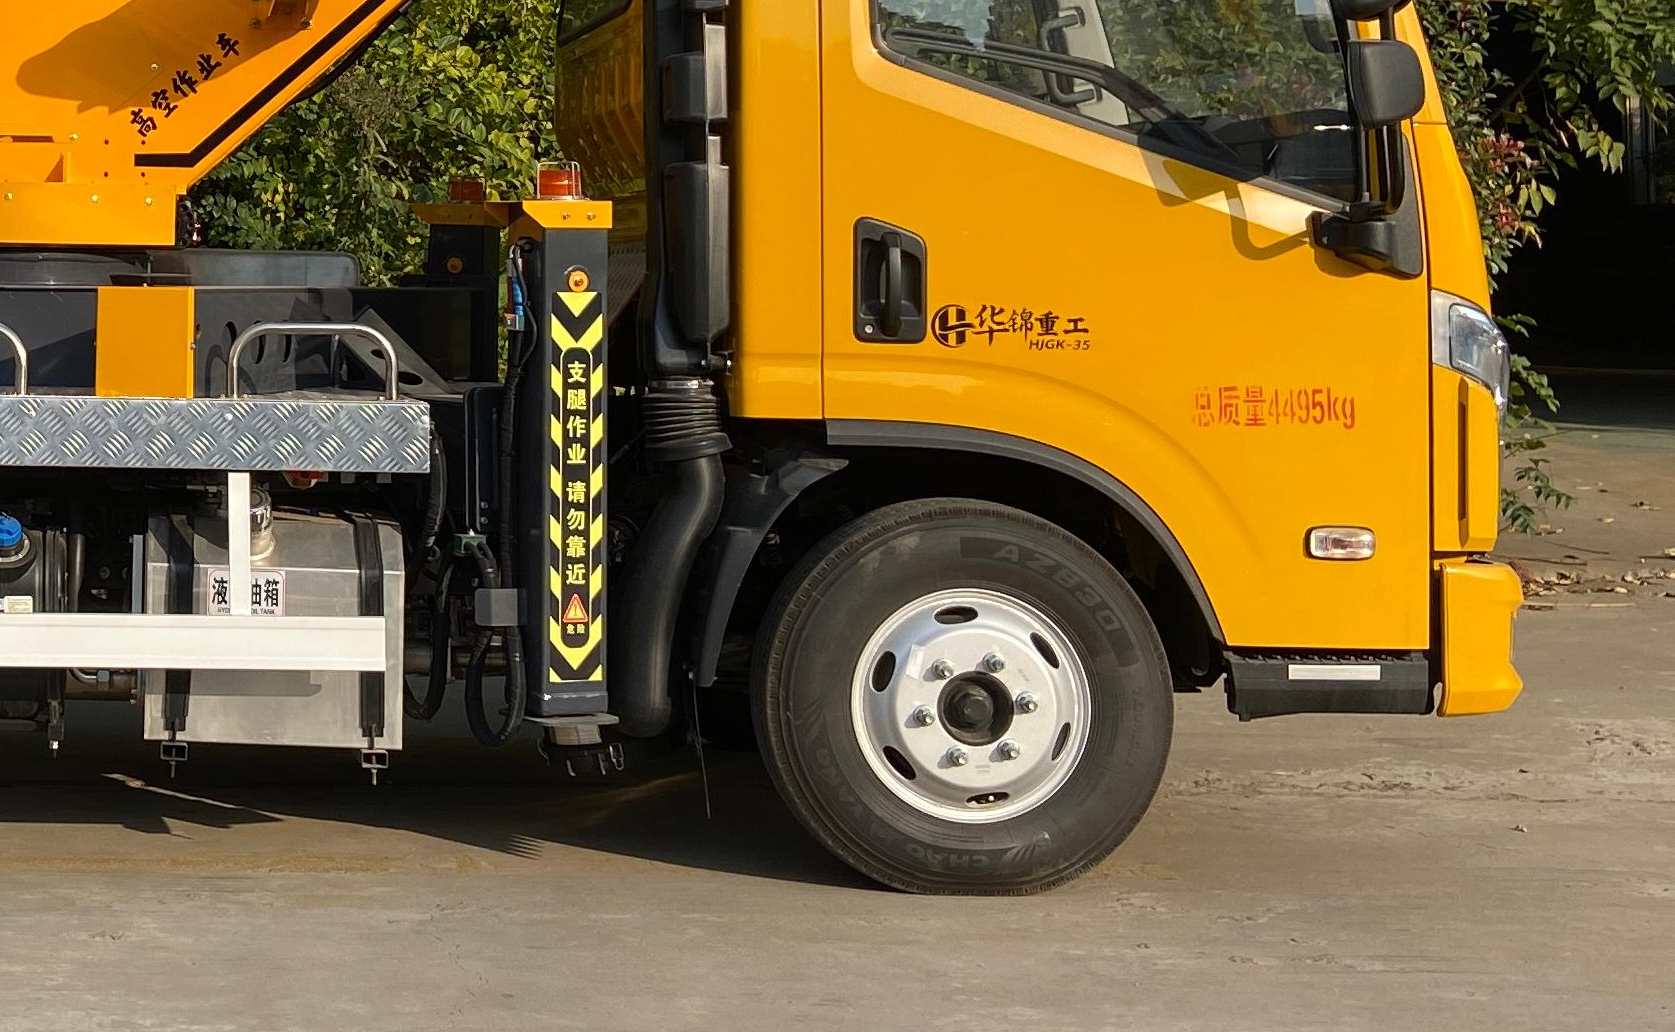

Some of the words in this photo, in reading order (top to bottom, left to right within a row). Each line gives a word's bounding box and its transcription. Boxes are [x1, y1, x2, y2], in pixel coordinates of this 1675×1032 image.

[130, 32, 240, 137] 高空作业车
[971, 304, 1090, 347] 华锦重工
[1028, 338, 1091, 351] HJGK-35
